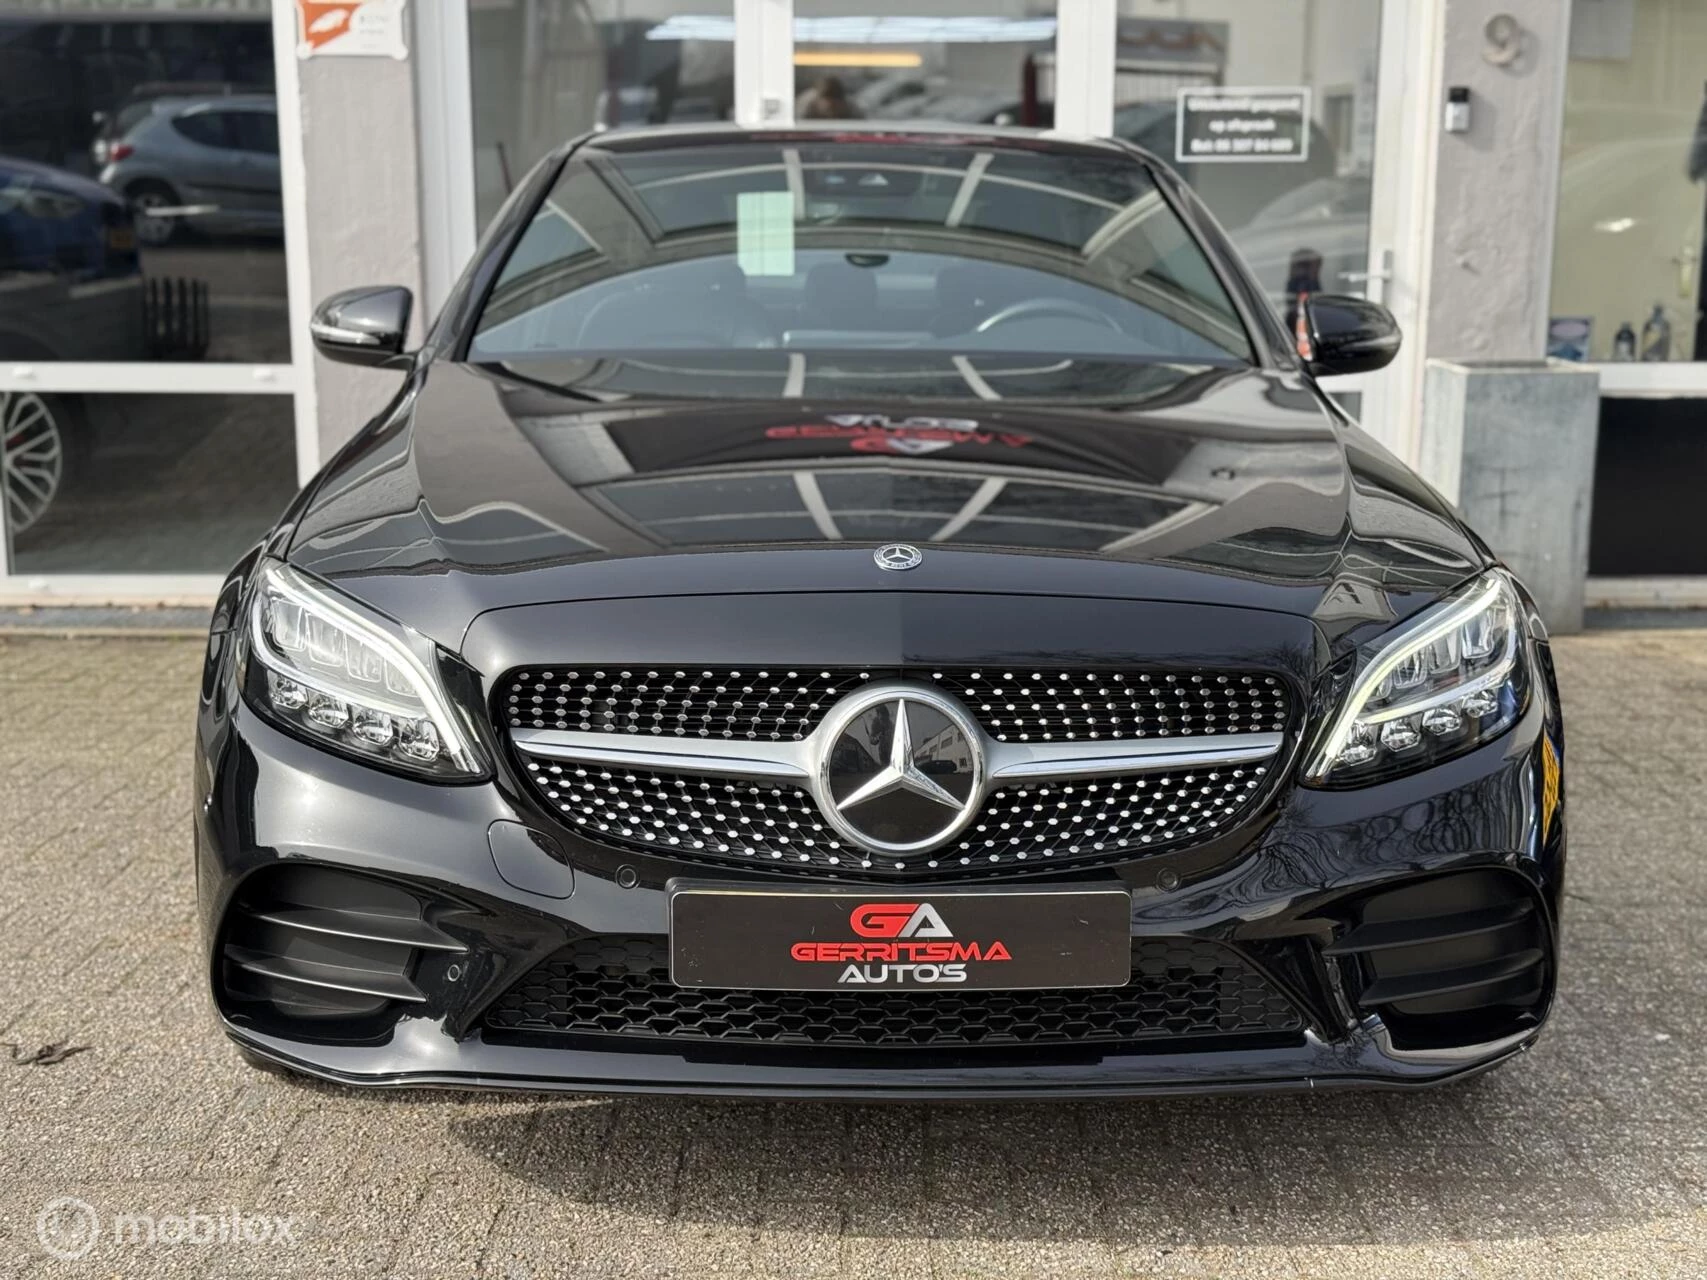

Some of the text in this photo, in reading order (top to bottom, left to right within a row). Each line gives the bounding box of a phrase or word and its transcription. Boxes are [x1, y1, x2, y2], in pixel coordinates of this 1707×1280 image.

[850, 902, 954, 938] GA
[790, 941, 1012, 962] GERRITSMA
[838, 964, 968, 984] AUTO'S
